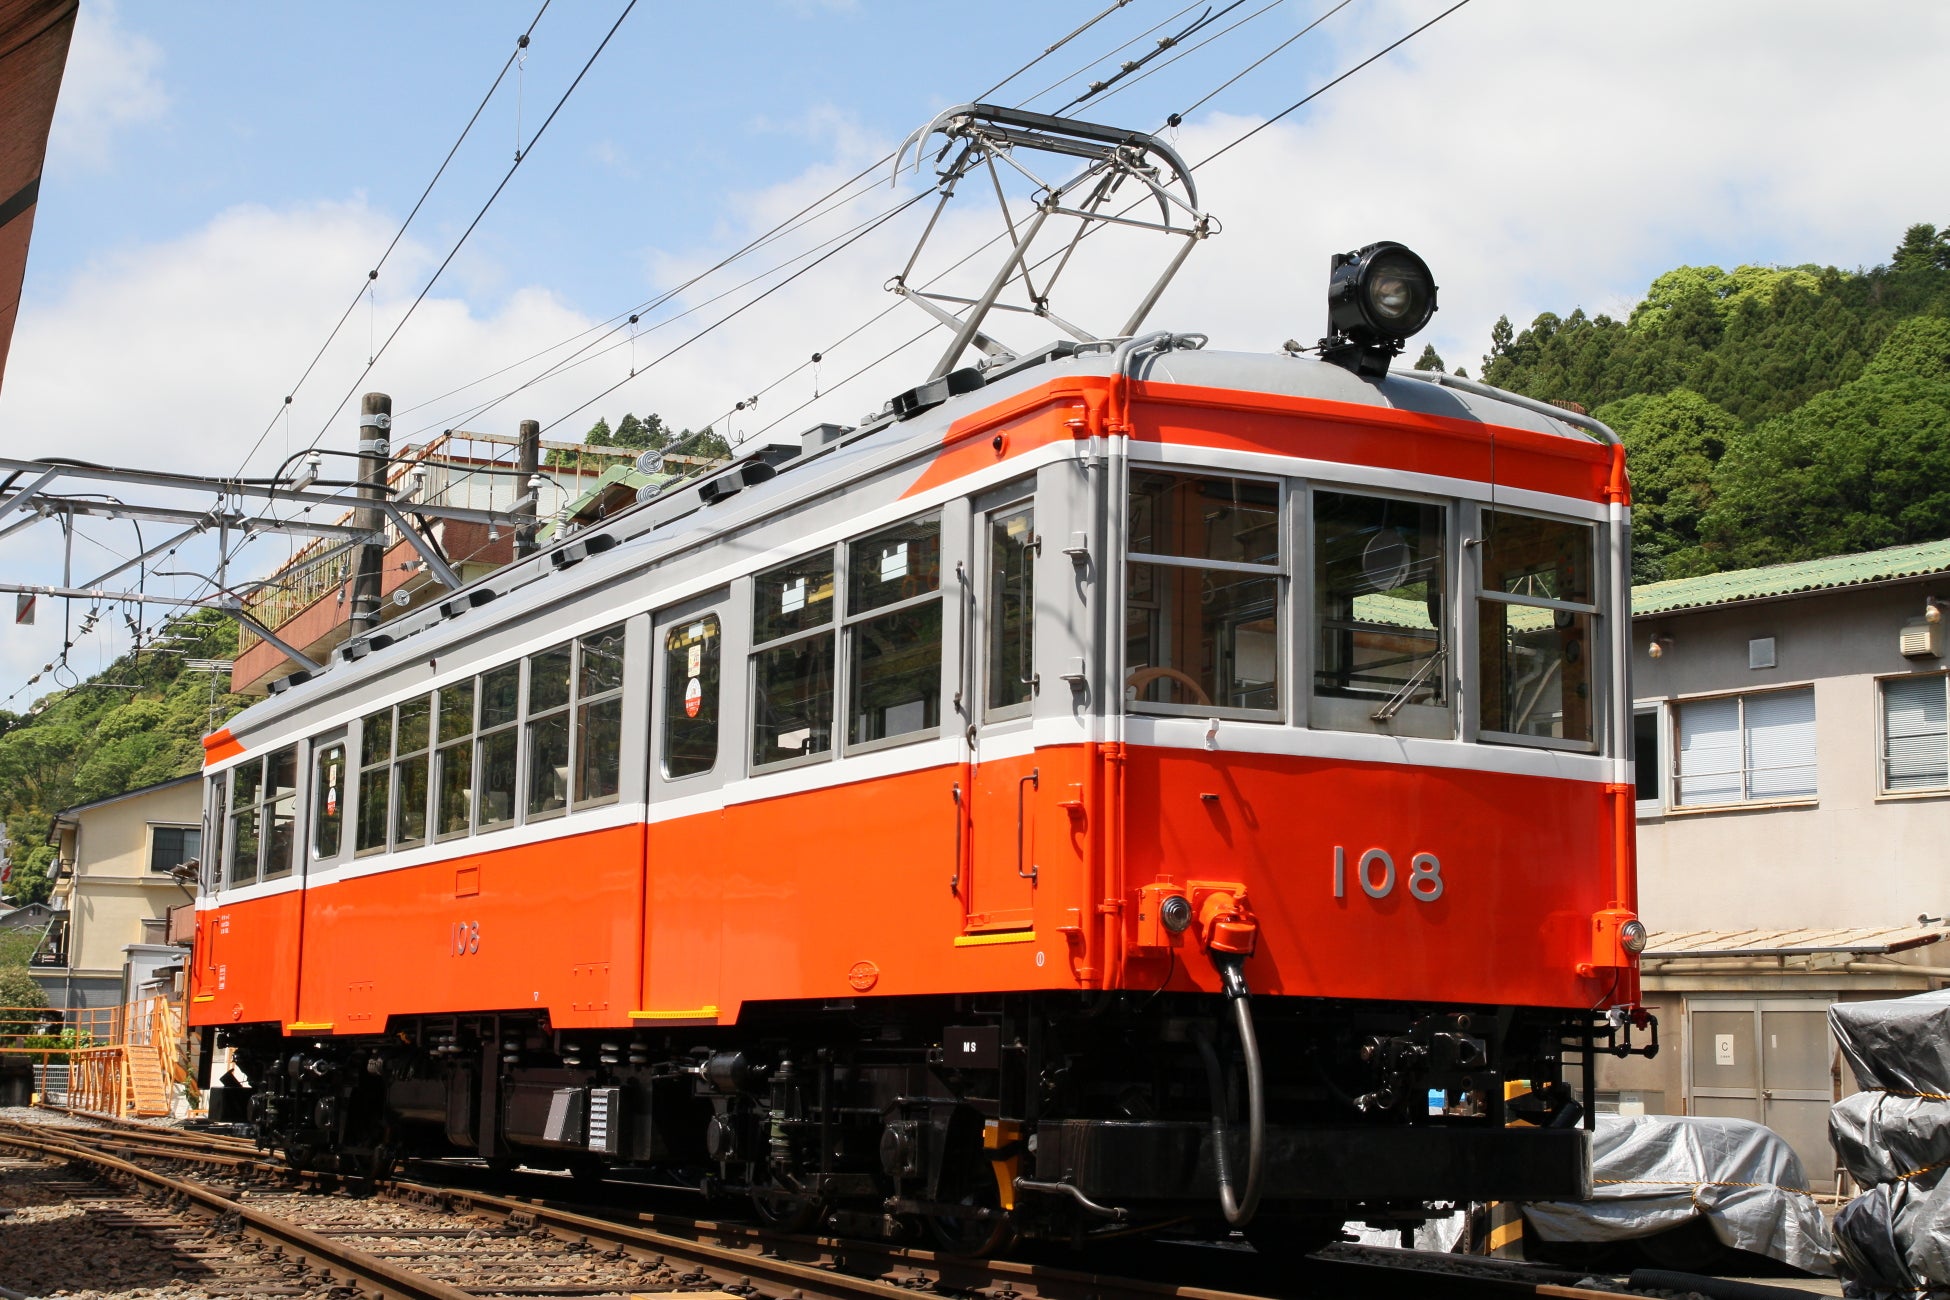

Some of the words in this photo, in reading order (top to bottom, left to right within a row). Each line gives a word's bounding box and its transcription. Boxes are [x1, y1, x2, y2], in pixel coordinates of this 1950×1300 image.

[1334, 846, 1443, 902] 108
[451, 921, 480, 956] 108
[963, 1041, 977, 1053] MS
[1721, 1041, 1729, 1052] C
